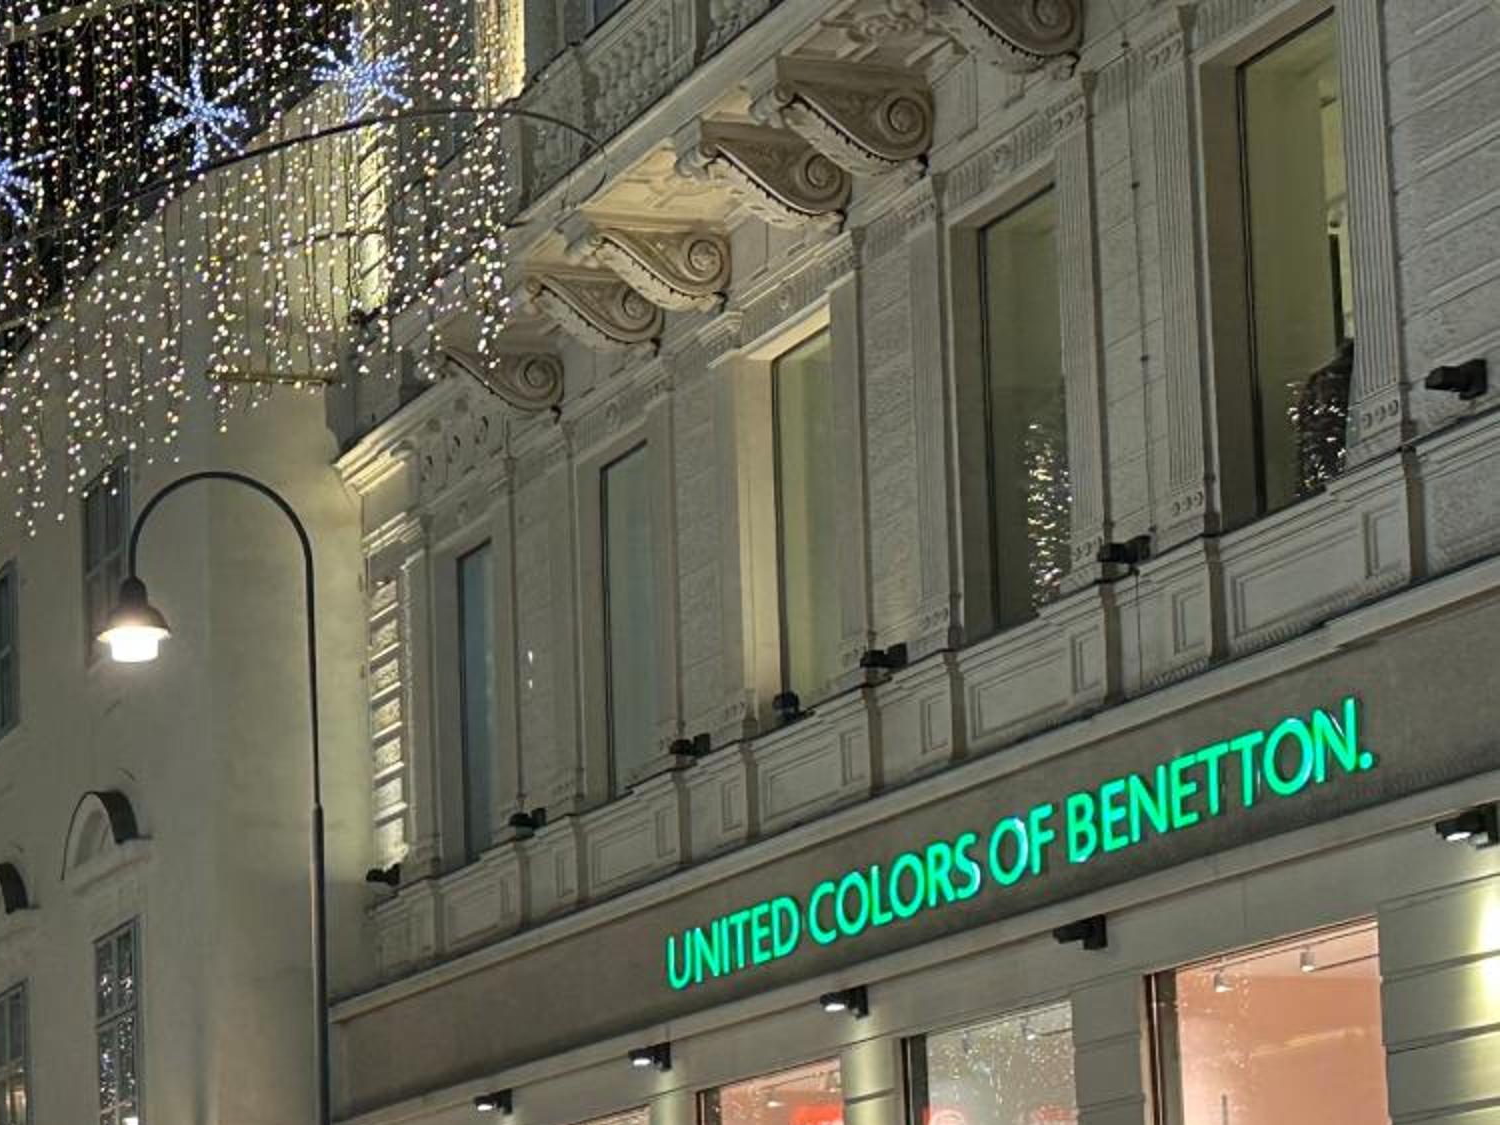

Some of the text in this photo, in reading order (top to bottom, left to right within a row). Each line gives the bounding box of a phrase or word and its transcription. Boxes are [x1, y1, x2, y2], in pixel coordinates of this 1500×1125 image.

[665, 896, 801, 990] UNITED
[808, 832, 982, 946] COLORS
[988, 803, 1055, 886] OF
